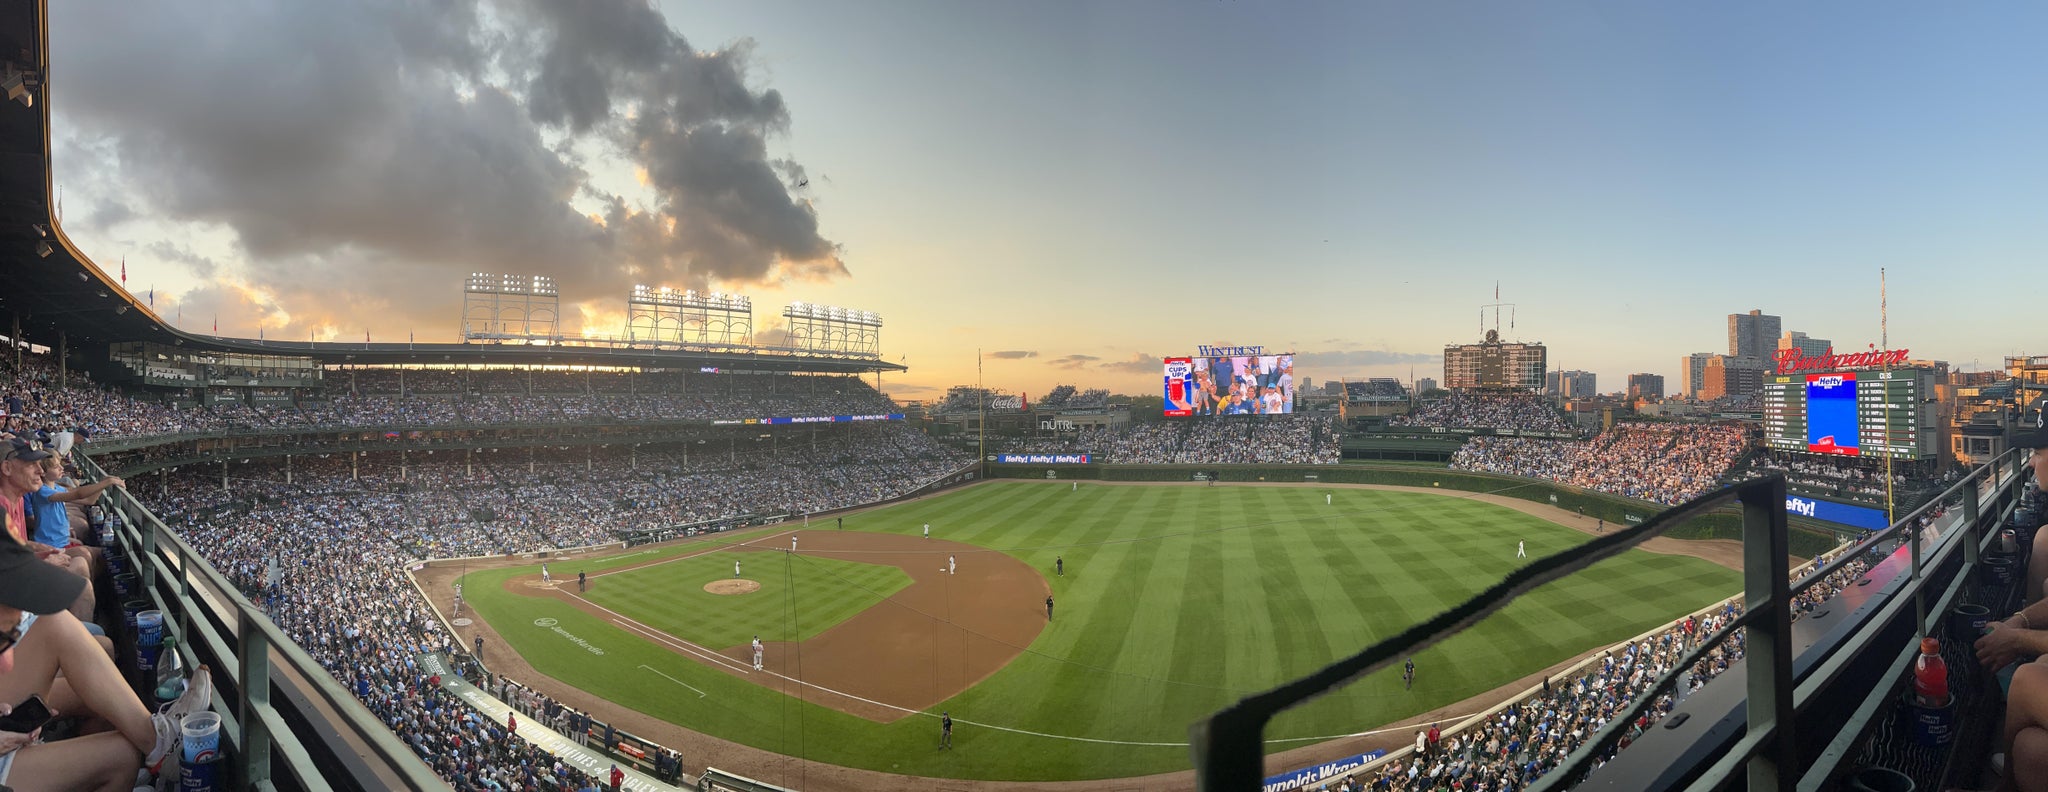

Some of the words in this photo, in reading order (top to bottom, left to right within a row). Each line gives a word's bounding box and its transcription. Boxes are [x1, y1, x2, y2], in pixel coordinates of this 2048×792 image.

[1198, 345, 1264, 357] WINTRUST
[1771, 343, 1910, 375] Budweiser
[1819, 377, 1842, 385] Hefty
[1519, 429, 1546, 437] Budweiser
[1005, 455, 1028, 464] Hefty!
[1029, 455, 1053, 464] Hefty!
[1055, 455, 1080, 464] Hefty!
[1785, 497, 1816, 517] efty!
[1625, 514, 1642, 523] SLOAN
[550, 626, 605, 656] JamesHardie
[549, 739, 598, 770] CONFINES
